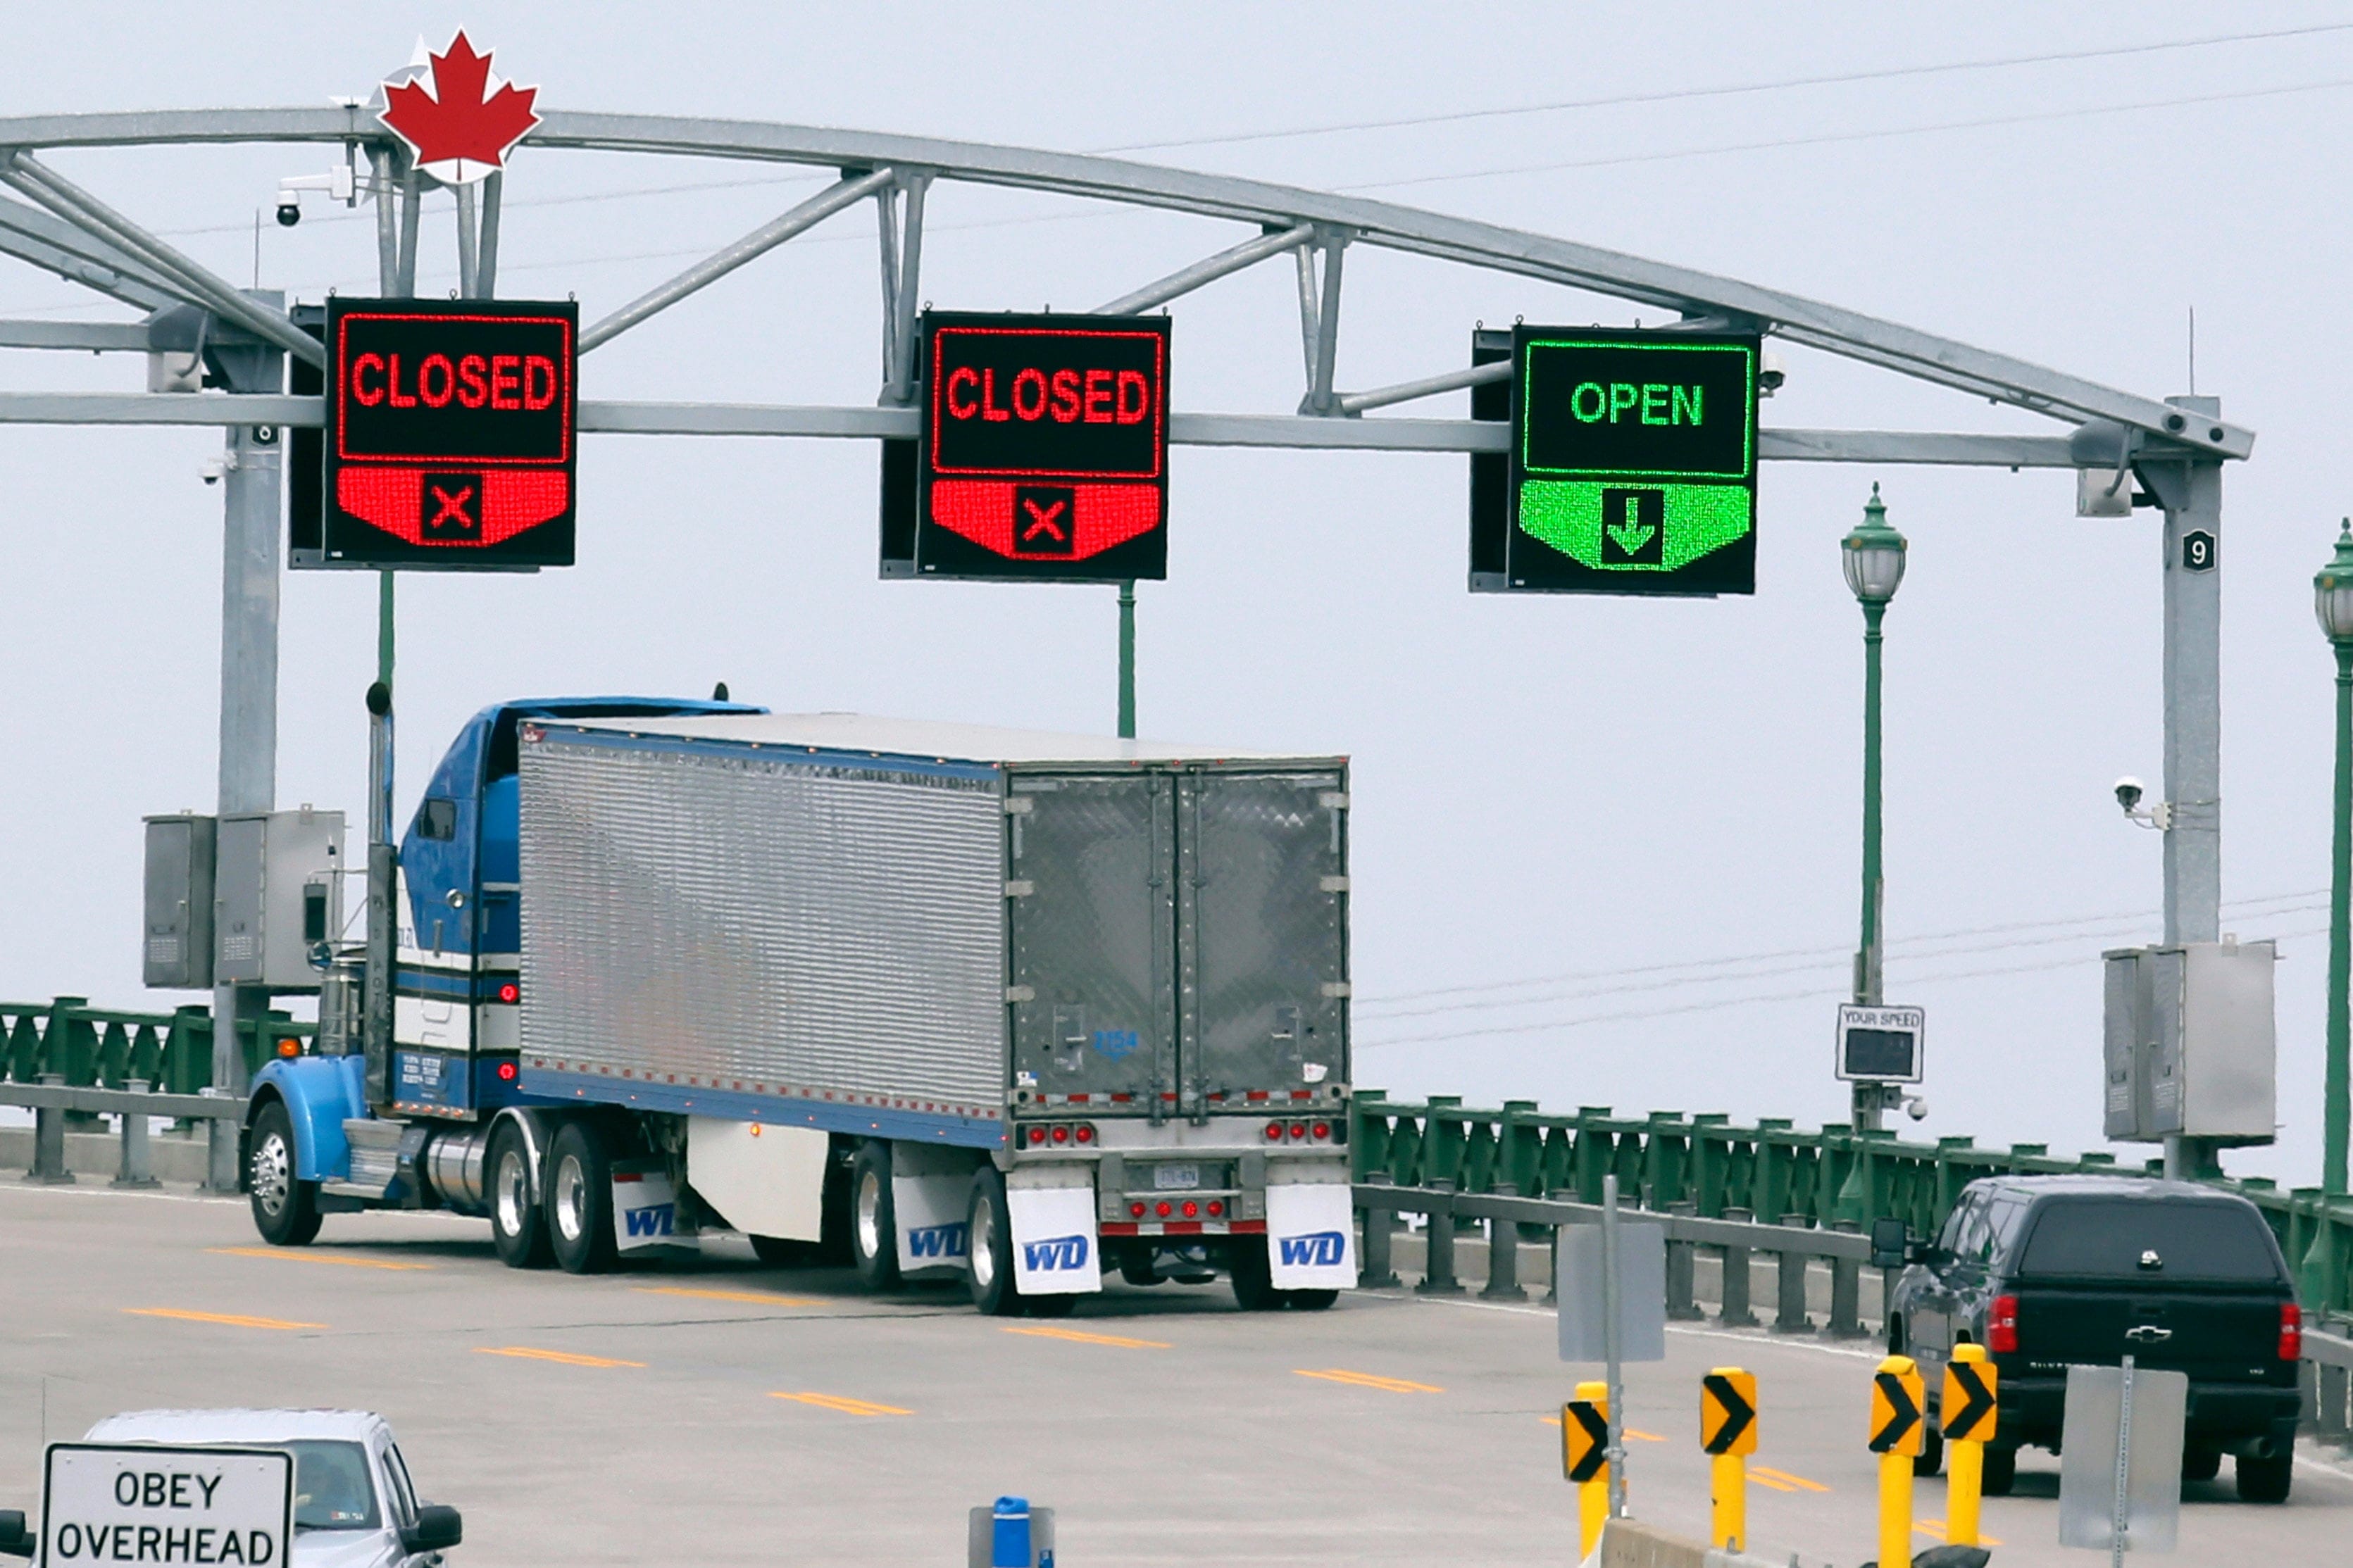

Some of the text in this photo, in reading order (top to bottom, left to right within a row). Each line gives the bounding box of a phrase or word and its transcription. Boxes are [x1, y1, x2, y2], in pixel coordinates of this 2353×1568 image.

[351, 352, 558, 410] CLOSED
[946, 366, 1150, 425] CLOSED
[1571, 382, 1704, 426] OPEN
[2192, 540, 2207, 565] 9
[1844, 1010, 1920, 1028] YOUR SPEED
[1023, 1235, 1088, 1271] WD
[1280, 1231, 1345, 1266] WD
[115, 1471, 223, 1509] OBEY
[57, 1523, 273, 1565] OVERHEAD
